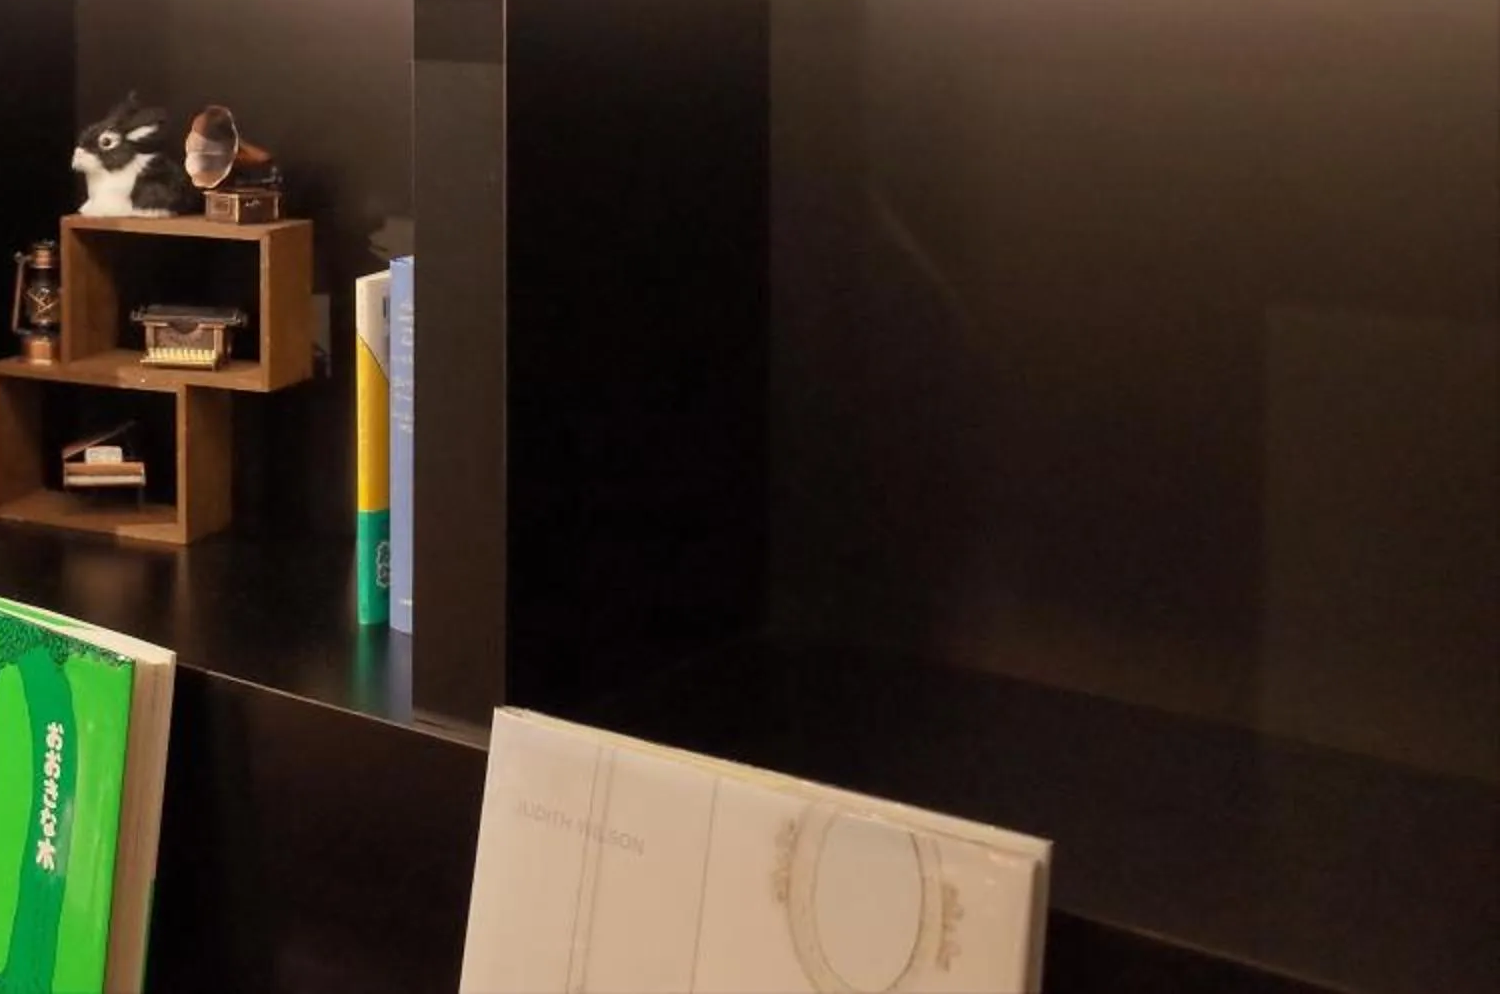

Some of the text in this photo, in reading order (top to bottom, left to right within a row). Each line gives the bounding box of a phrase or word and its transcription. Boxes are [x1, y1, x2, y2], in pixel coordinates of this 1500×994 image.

[35, 721, 65, 872] おおきな木
